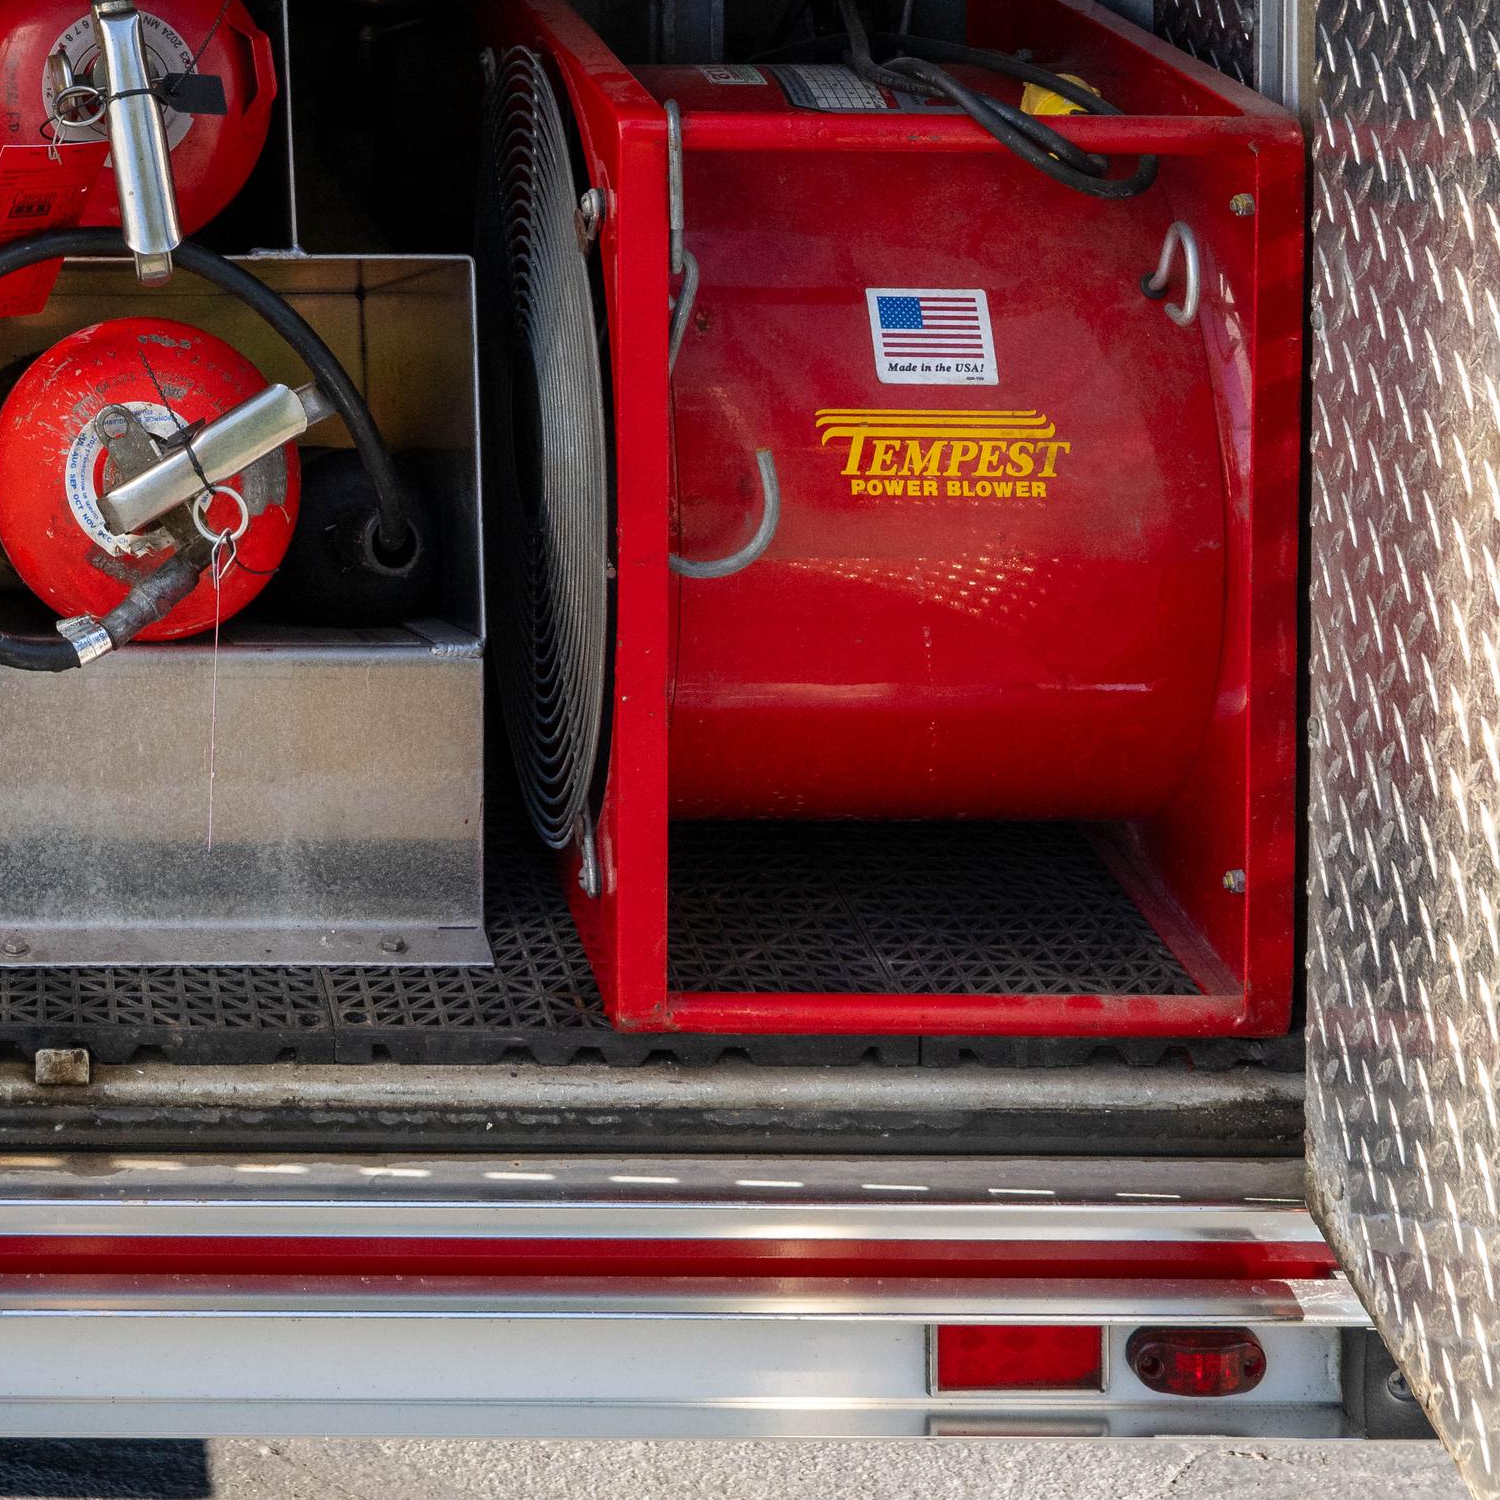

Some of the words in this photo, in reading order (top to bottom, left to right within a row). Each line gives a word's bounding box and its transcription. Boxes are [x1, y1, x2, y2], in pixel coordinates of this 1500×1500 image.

[143, 16, 160, 29] MN
[162, 27, 182, 49] 2024
[887, 362, 917, 373] Made
[920, 363, 932, 372] in
[935, 363, 953, 373] the
[955, 363, 985, 373] USA!
[76, 432, 89, 447] JUL
[69, 450, 80, 469] AUG
[822, 425, 1071, 478] TEMPEST
[69, 473, 77, 490] SEP
[851, 479, 939, 496] POWER
[947, 480, 1047, 497] BLOWER
[73, 493, 84, 511] OCT
[82, 513, 96, 529] NOV
